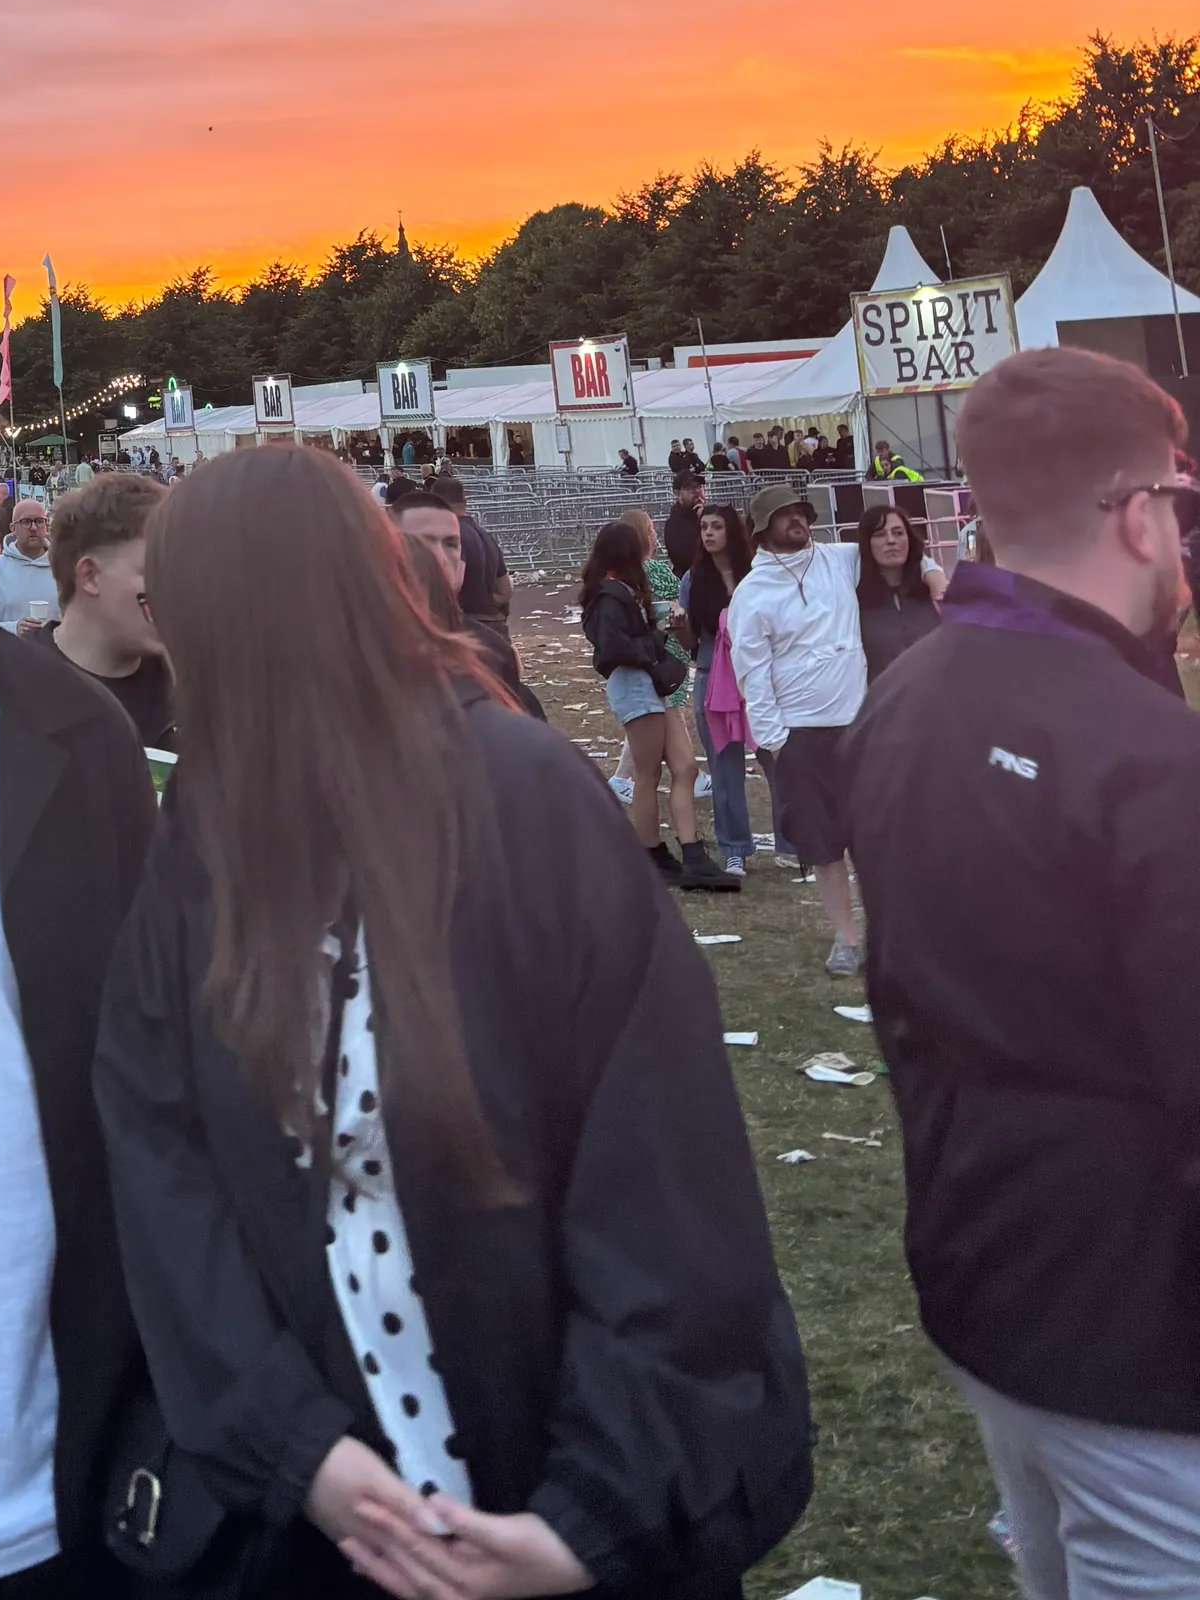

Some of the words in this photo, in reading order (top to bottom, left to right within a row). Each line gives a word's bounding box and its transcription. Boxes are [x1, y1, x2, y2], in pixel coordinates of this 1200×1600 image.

[862, 288, 1001, 347] SPIRIT
[570, 351, 611, 398] BAR
[893, 341, 979, 383] BAR
[171, 394, 186, 424] BAR
[262, 384, 283, 418] BAR
[391, 371, 419, 410] BAR
